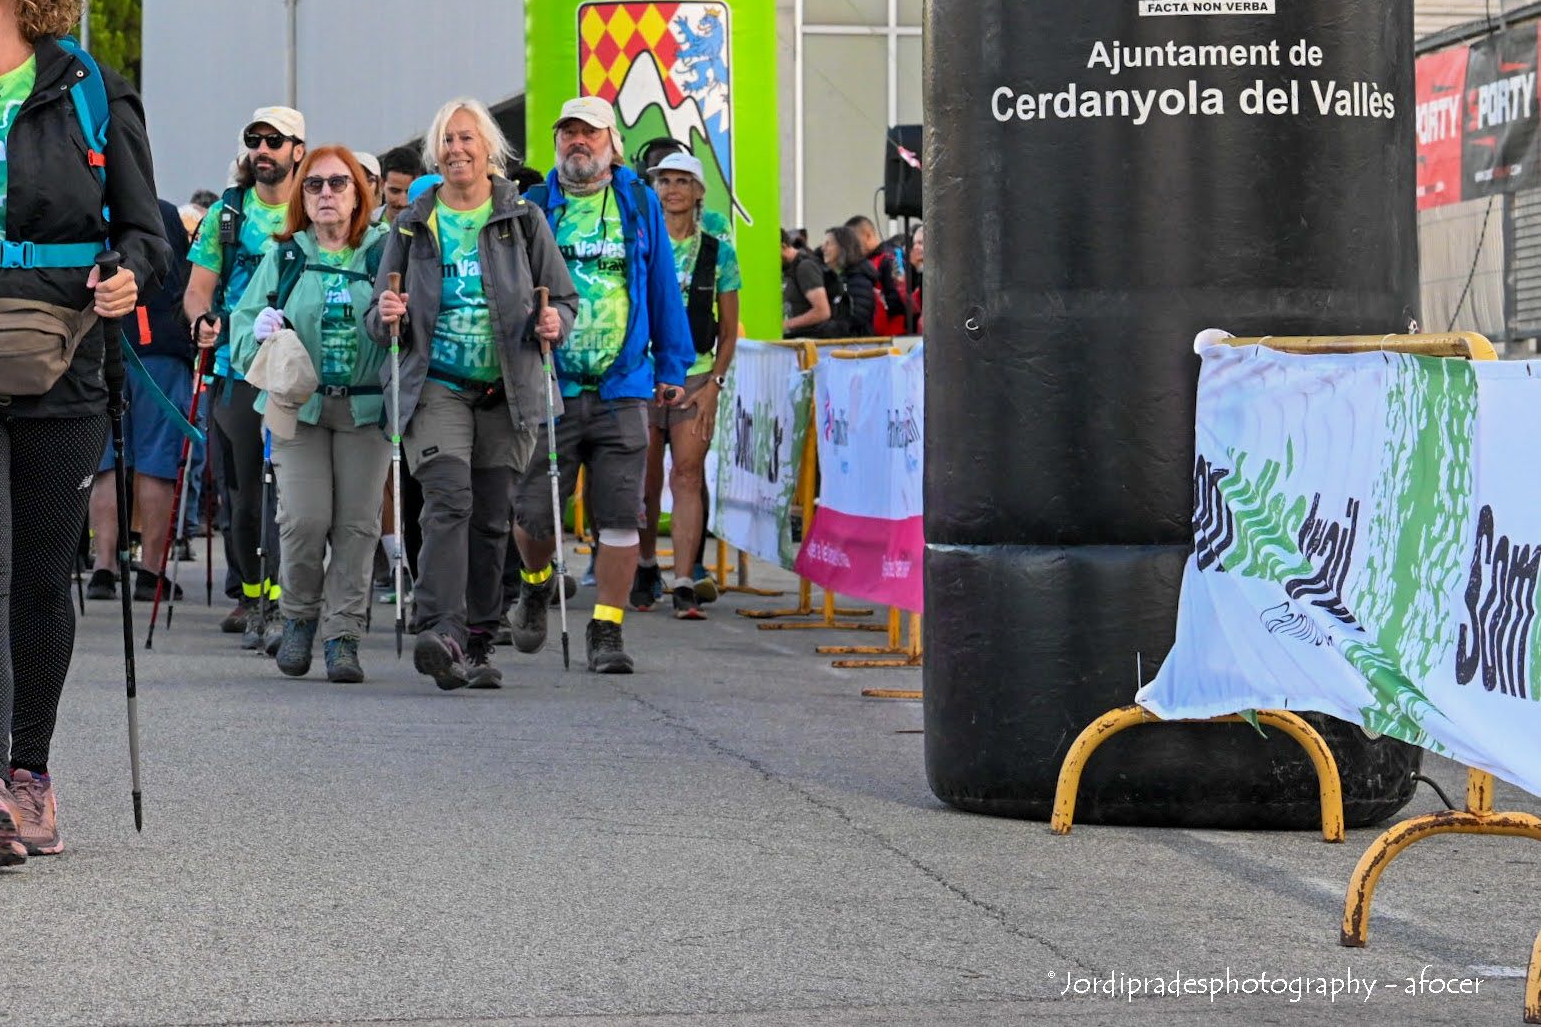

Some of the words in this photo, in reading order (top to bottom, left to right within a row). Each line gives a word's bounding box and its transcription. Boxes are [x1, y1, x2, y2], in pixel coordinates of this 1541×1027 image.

[1147, 2, 1189, 14] FACTA
[1192, 2, 1223, 13] NON
[1225, 1, 1269, 12] VERBA
[1086, 39, 1281, 75] Ajuntament
[1288, 38, 1323, 67] de
[991, 79, 1225, 125] Cerdanyola
[1239, 79, 1299, 115] del
[1312, 79, 1396, 119] Vallès
[1416, 94, 1461, 146] ORTY
[1468, 71, 1536, 132] SPORTY
[1454, 504, 1541, 702] Som
